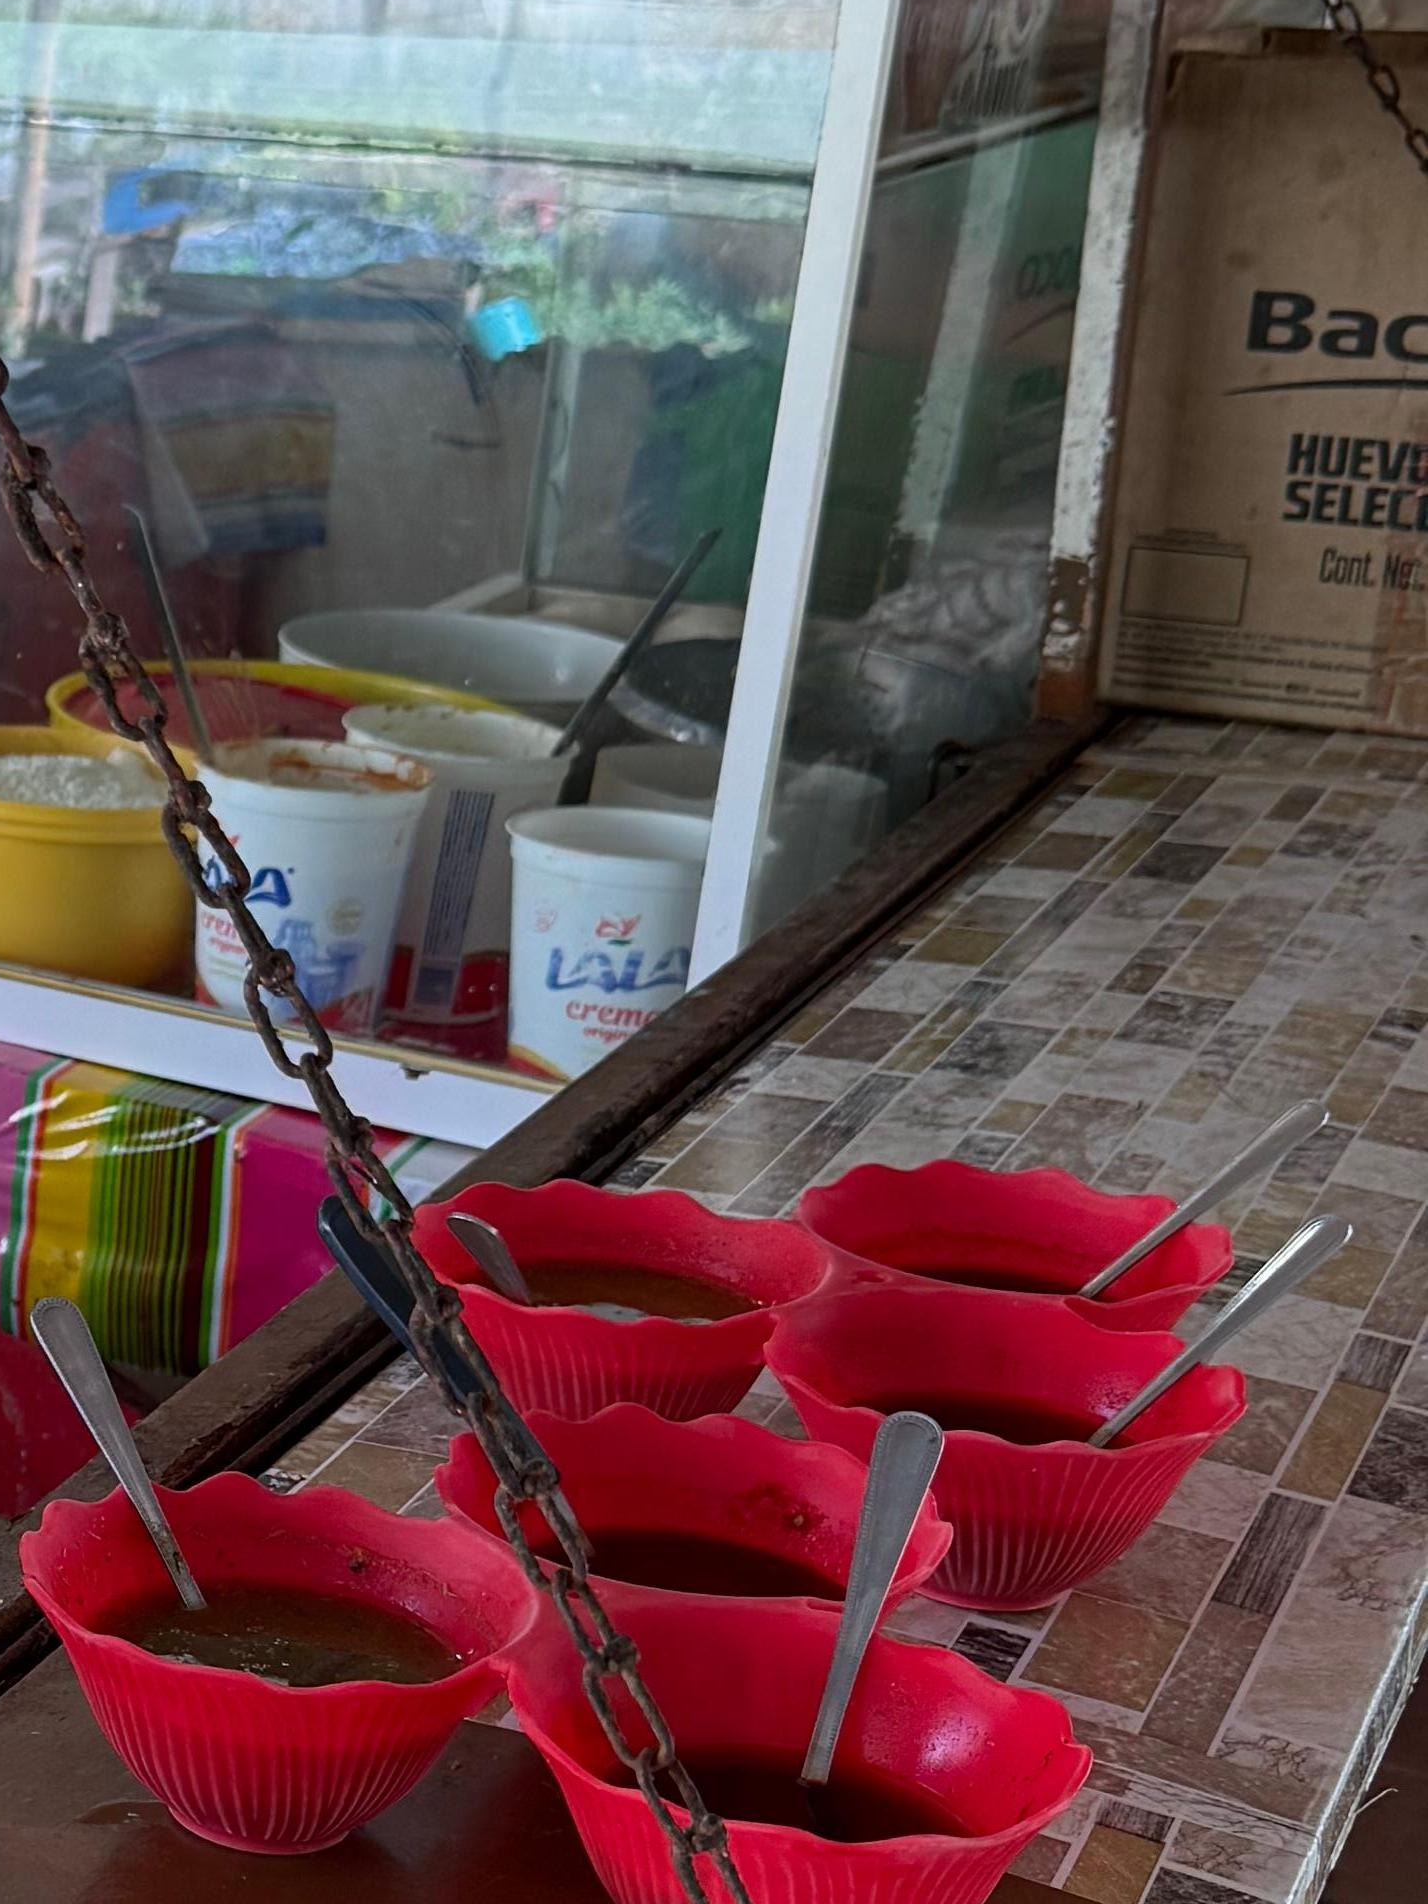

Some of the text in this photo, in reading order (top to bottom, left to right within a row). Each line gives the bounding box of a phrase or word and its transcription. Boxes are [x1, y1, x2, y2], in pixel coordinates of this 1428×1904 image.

[1246, 289, 1428, 364] Bac
[1319, 548, 1374, 587] Cont.
[546, 947, 691, 992] LALA
